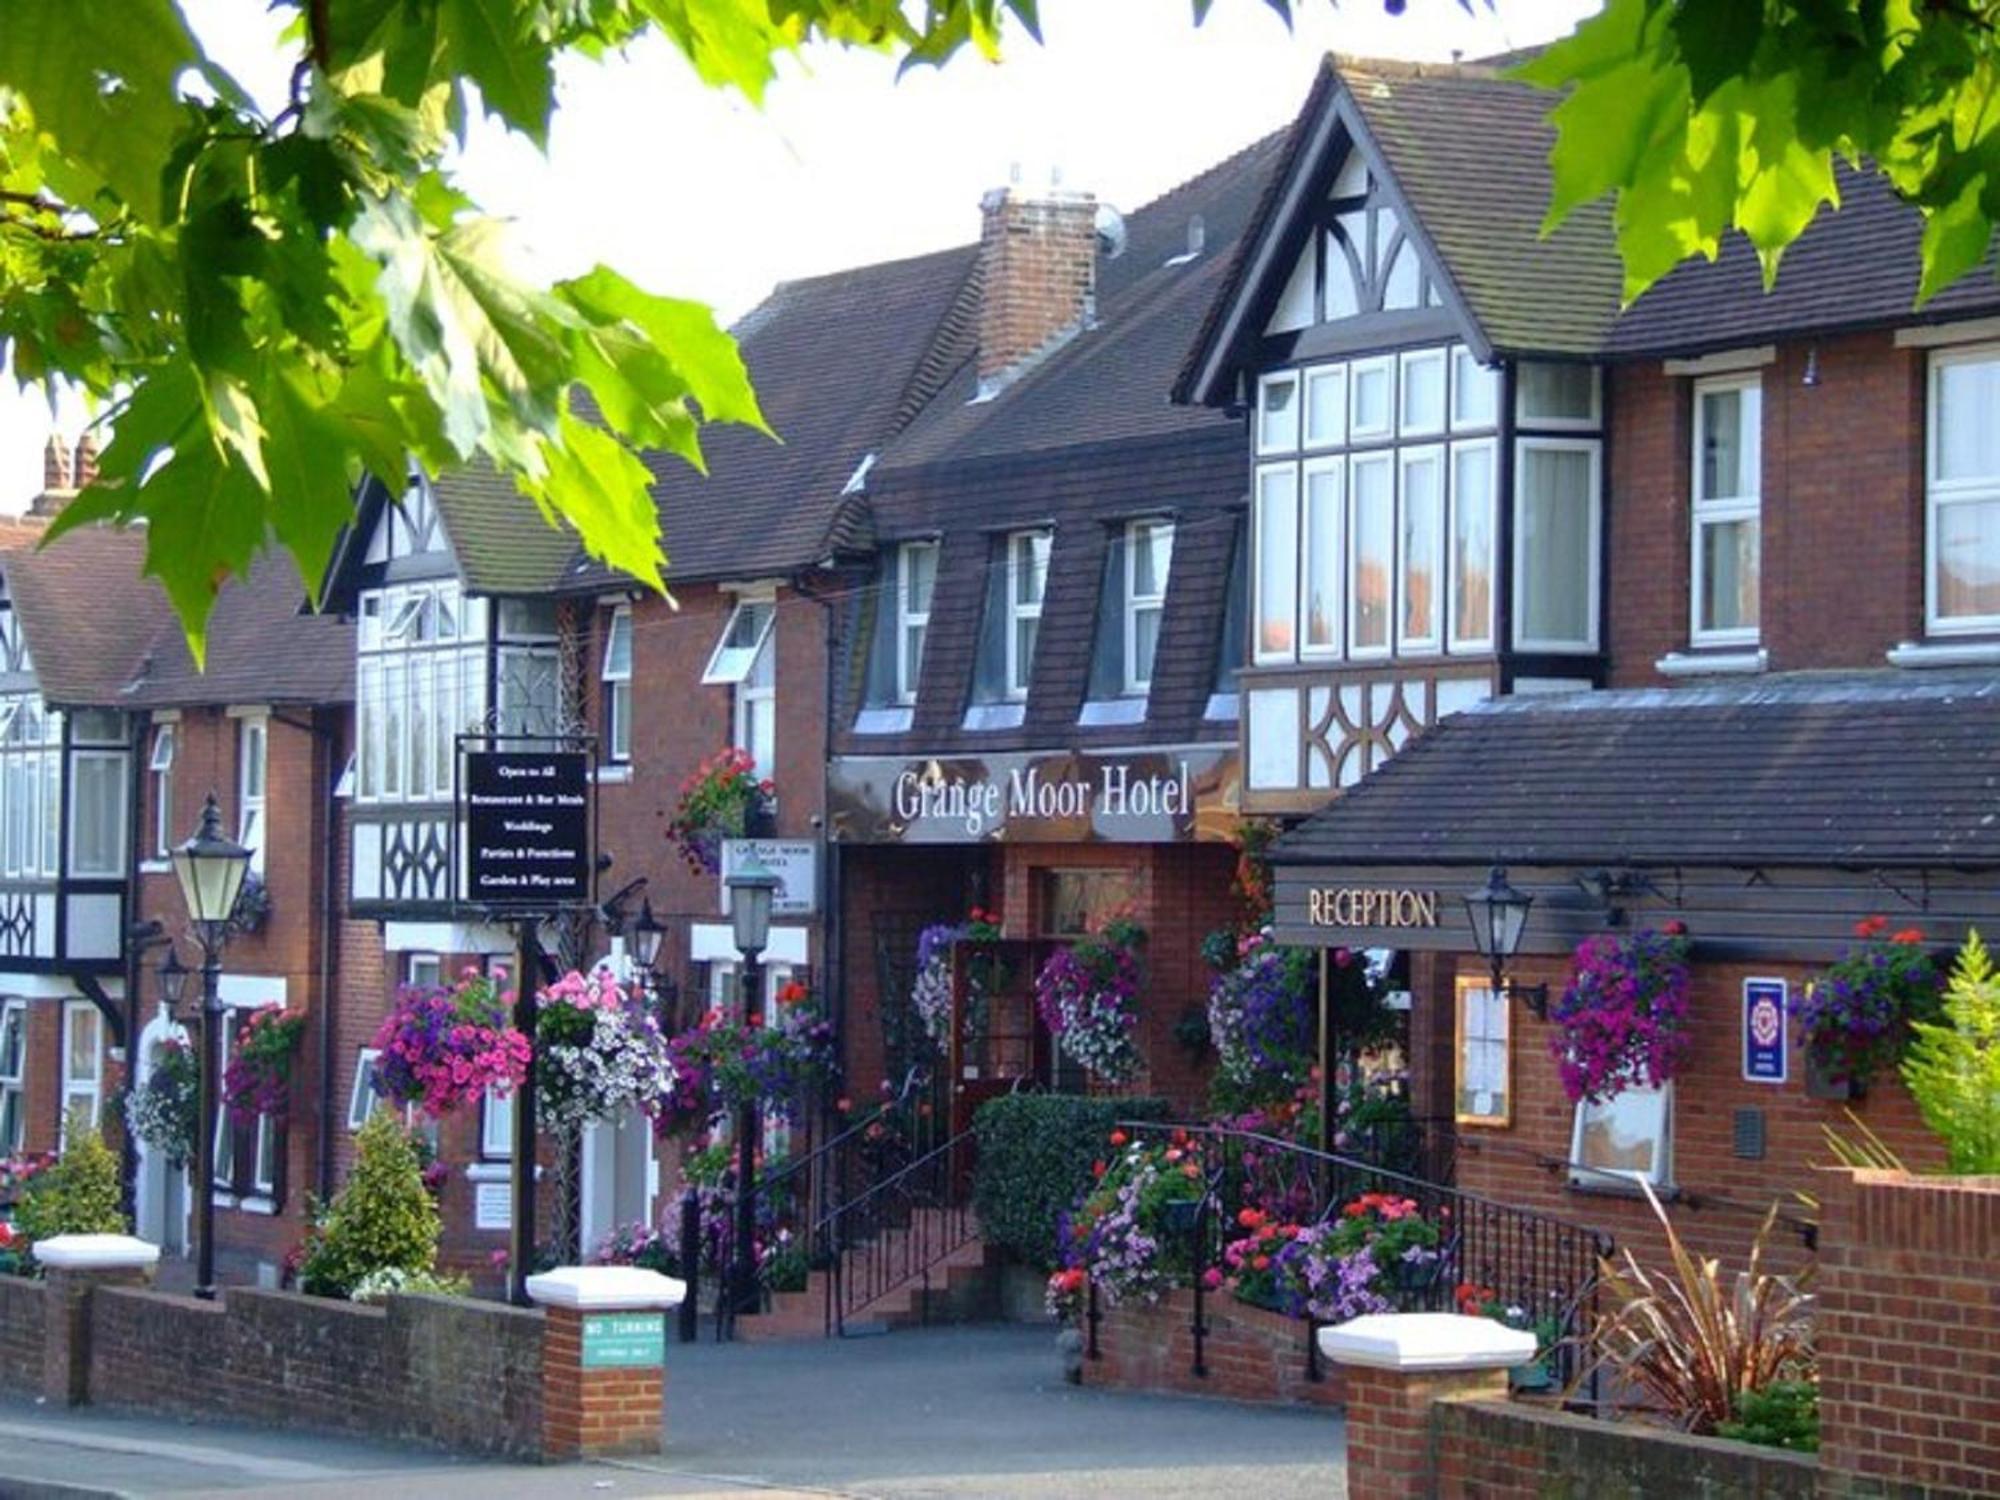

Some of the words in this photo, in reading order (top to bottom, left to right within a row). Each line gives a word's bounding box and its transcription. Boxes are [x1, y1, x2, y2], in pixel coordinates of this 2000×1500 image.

[498, 767, 526, 778] Open
[528, 768, 540, 777] to
[541, 766, 556, 777] All
[471, 794, 523, 805] Restaurant
[537, 794, 553, 805] Bar
[896, 771, 999, 834] Grange
[1009, 766, 1091, 819] Moor
[1101, 760, 1189, 816] Hotel
[503, 821, 553, 833] Weddings
[480, 848, 514, 859] Parties
[527, 848, 576, 859] Functions
[480, 875, 518, 886] Garden
[530, 875, 551, 888] Play
[553, 877, 576, 885] area
[1308, 887, 1437, 926] RECEPTION
[585, 1321, 602, 1335] NO
[612, 1319, 663, 1334] TURNING
